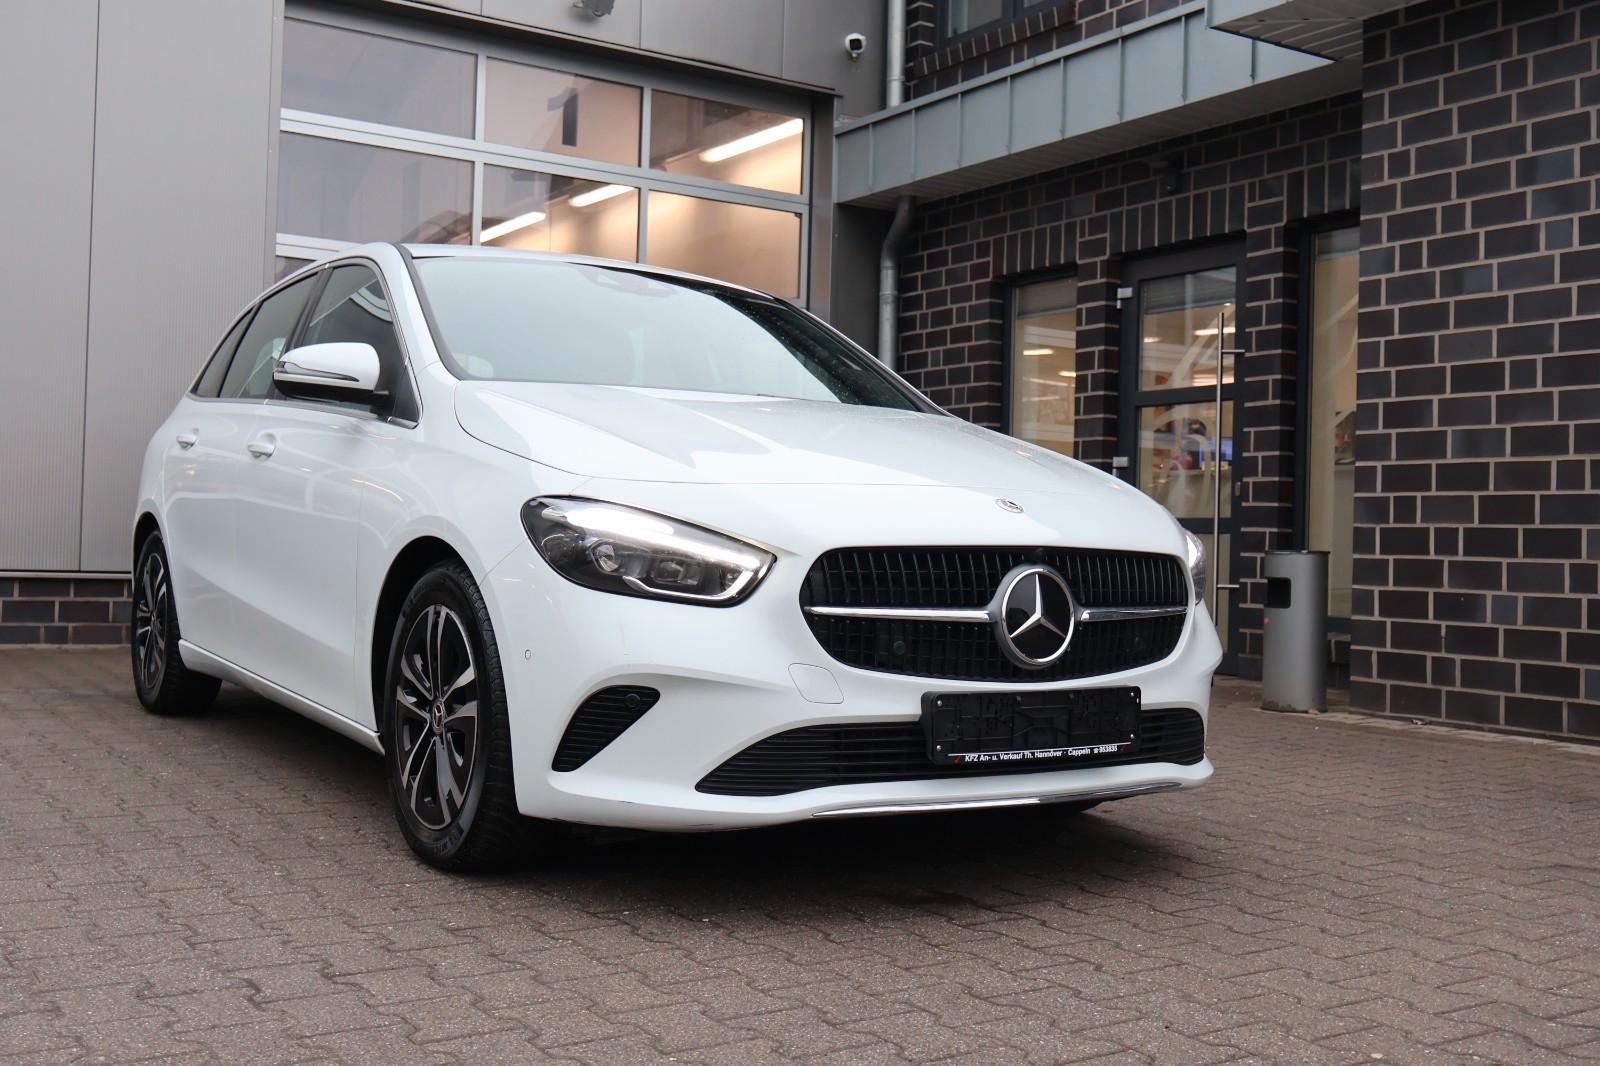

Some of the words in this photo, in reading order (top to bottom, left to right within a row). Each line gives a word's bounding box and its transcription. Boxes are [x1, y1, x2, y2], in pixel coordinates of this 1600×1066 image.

[547, 87, 578, 147] 1
[965, 754, 978, 762] KFZ
[1000, 752, 1023, 760] Verkauf
[1024, 751, 1034, 759] Th.
